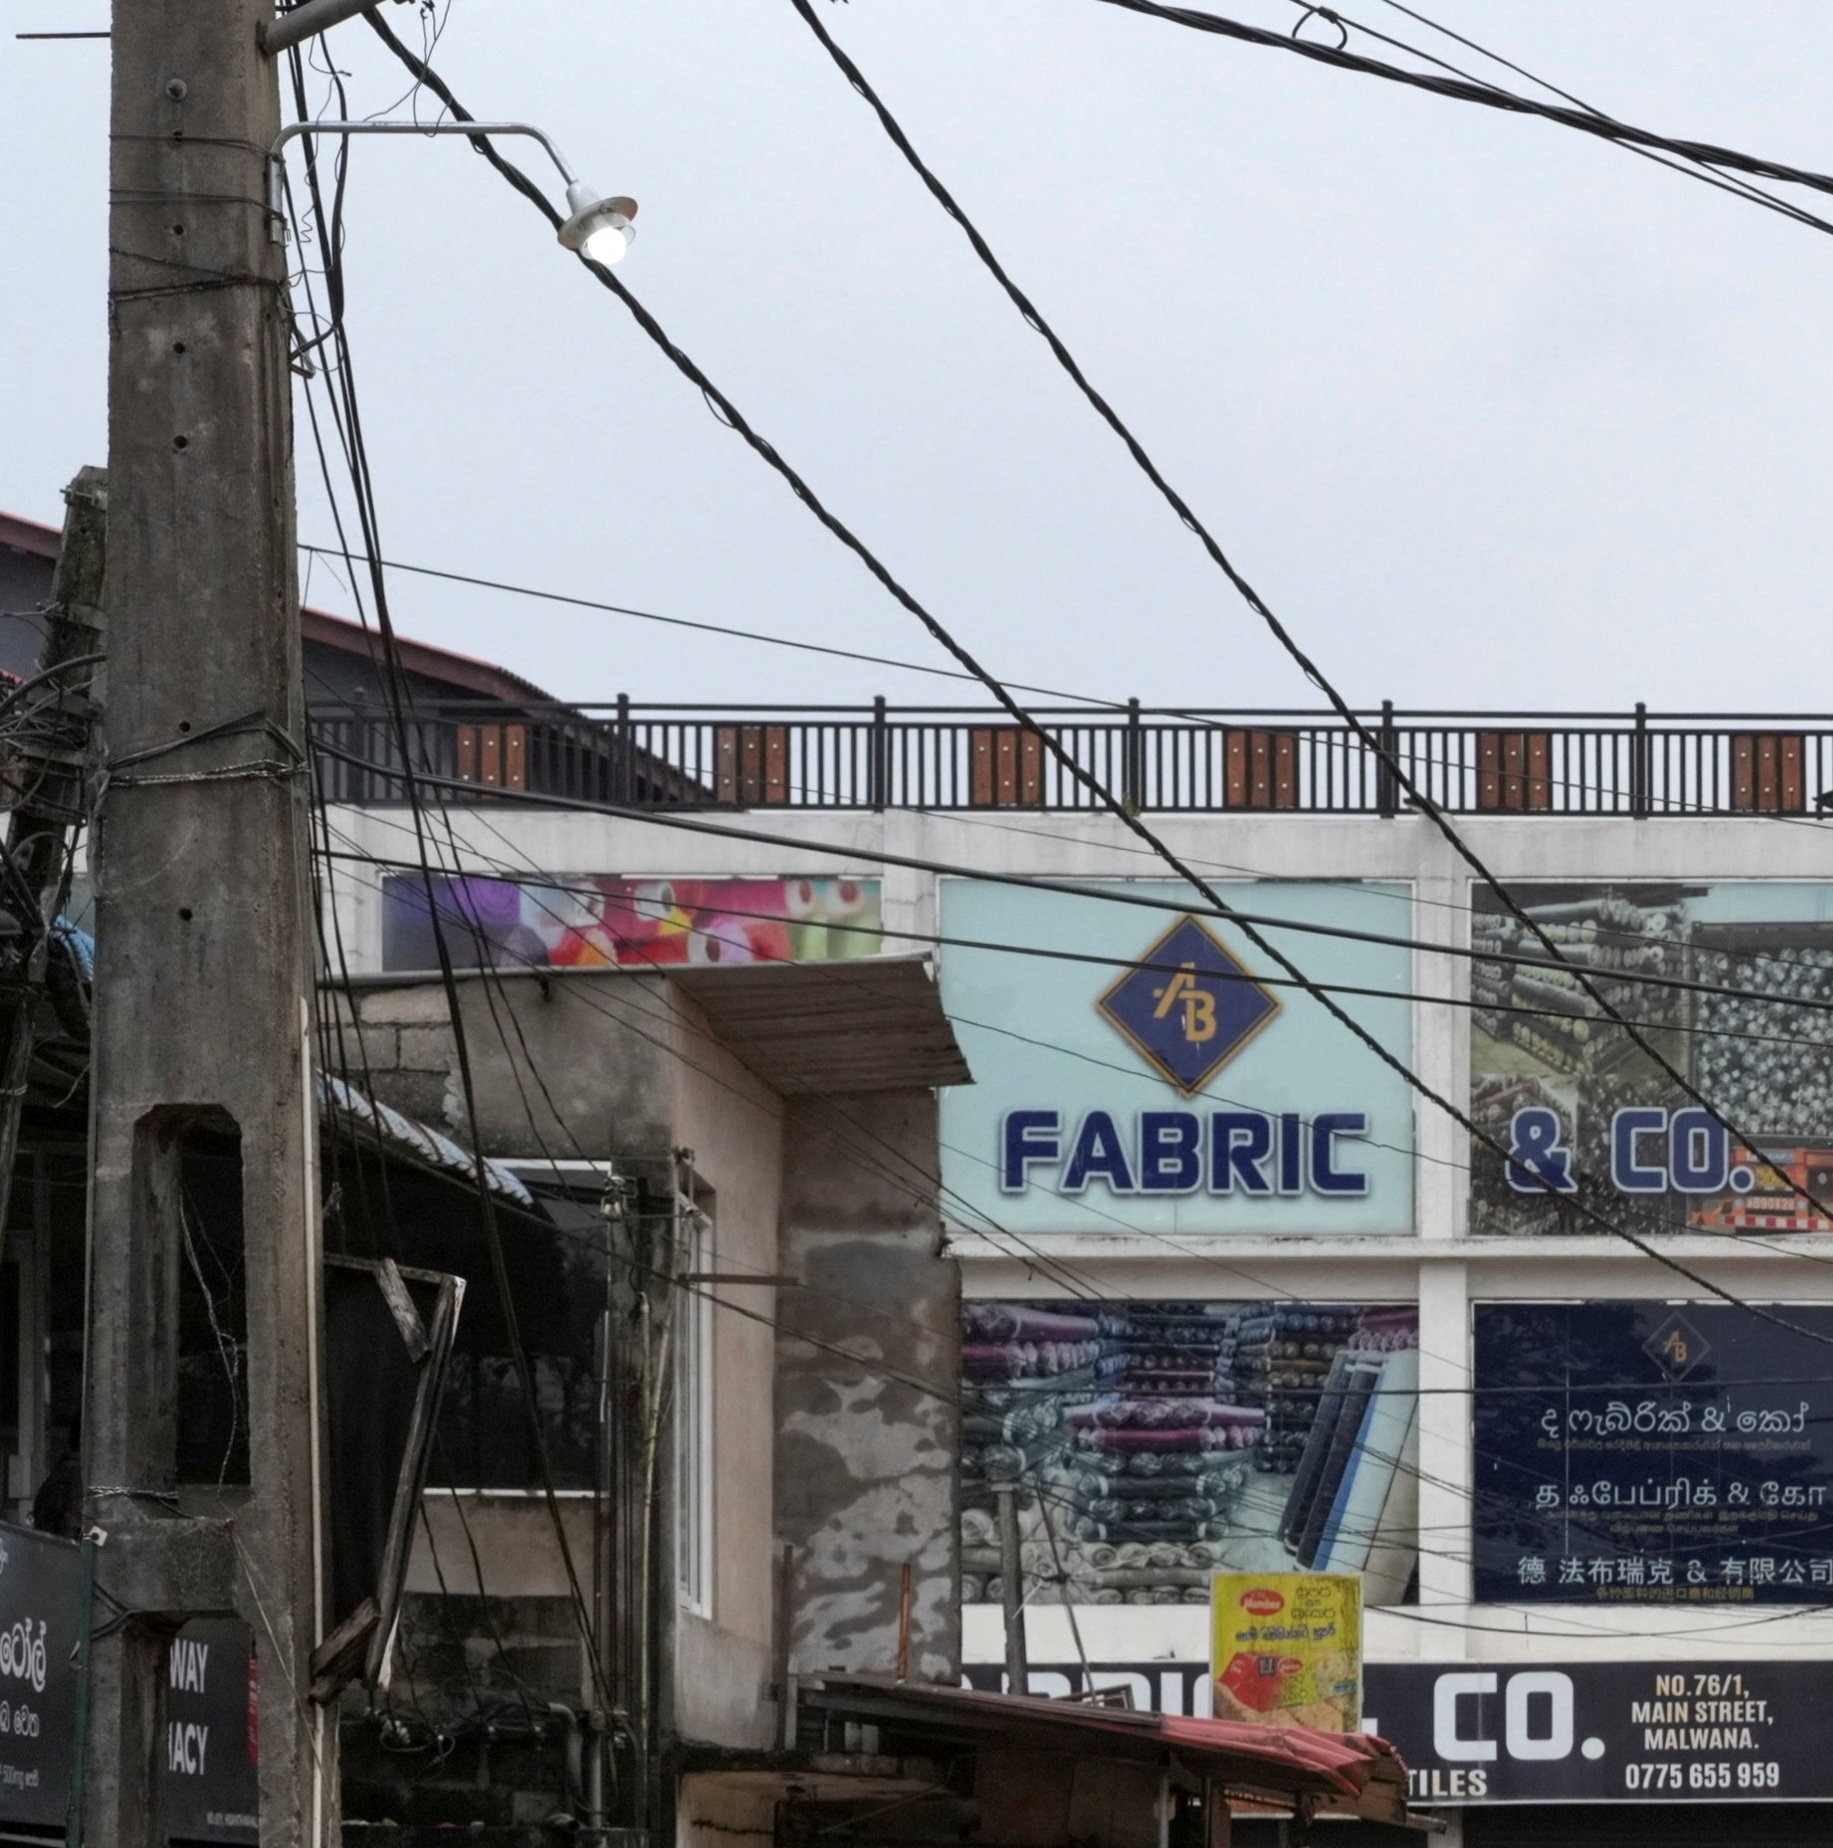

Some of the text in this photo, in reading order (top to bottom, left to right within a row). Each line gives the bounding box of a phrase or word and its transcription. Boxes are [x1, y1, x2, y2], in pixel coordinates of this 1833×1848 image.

[1001, 1109, 1369, 1196] FABRIC
[1505, 1107, 1755, 1193] & CO.
[1701, 1407, 1726, 1433] &
[1727, 1481, 1750, 1506] &
[1760, 1480, 1827, 1506] கோ
[1517, 1555, 1547, 1585] 德
[1558, 1555, 1674, 1585] 法布瑞克
[1686, 1559, 1707, 1585] &
[169, 1638, 208, 1693] WAY
[1656, 1674, 1750, 1699] NO.76/1,
[1433, 1670, 1606, 1762] CO.
[1631, 1700, 1773, 1726] MAIN STREET,
[168, 1721, 208, 1775] ACY
[1644, 1727, 1759, 1750] MALWANA.
[1625, 1762, 1780, 1789] 0775 655 959
